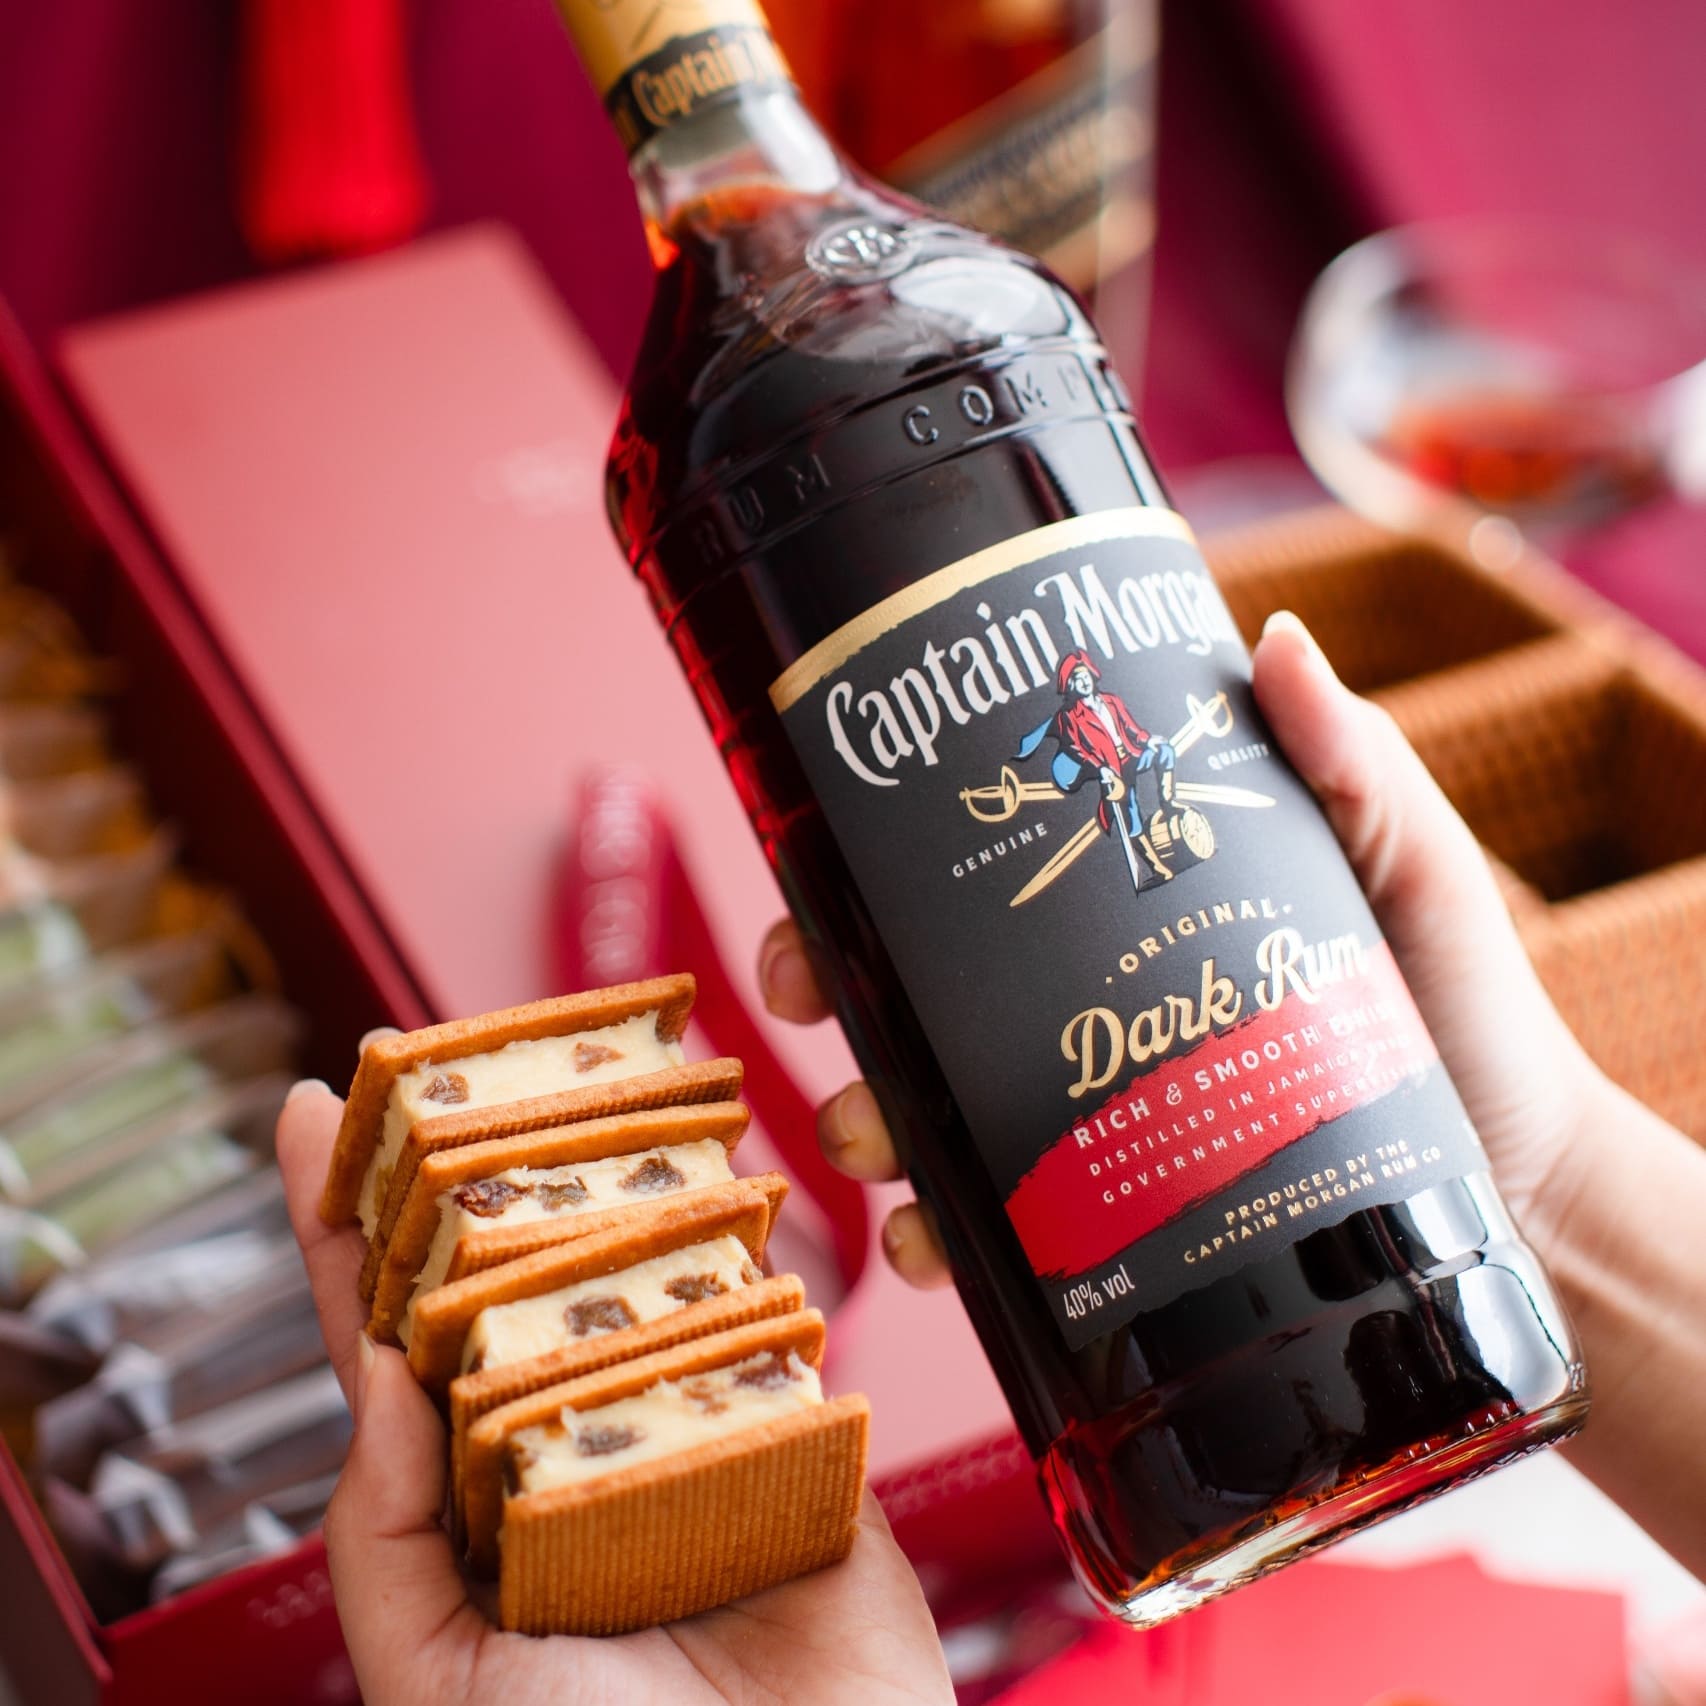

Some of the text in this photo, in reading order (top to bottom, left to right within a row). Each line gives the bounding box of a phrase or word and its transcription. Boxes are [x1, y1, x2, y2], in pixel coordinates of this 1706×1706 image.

[826, 602, 1060, 787] Captain
[1033, 563, 1236, 660] Morga
[952, 822, 1048, 879] GENUINE
[1118, 897, 1277, 974] ORIGINAL
[1060, 927, 1369, 1099] Dark Rum
[1073, 1097, 1151, 1149] RICH
[1165, 1082, 1184, 1107] &
[1194, 1023, 1321, 1091] SMOOTH
[1090, 1107, 1216, 1176] DISTILLED
[1230, 1090, 1254, 1112] IN
[1102, 1112, 1281, 1205] GOVERNMENT
[1183, 1145, 1441, 1264] CAPTAIN MORGAN RUM CO
[1225, 1139, 1409, 1226] PRODUCED BY THE
[1063, 1280, 1104, 1321] 40%
